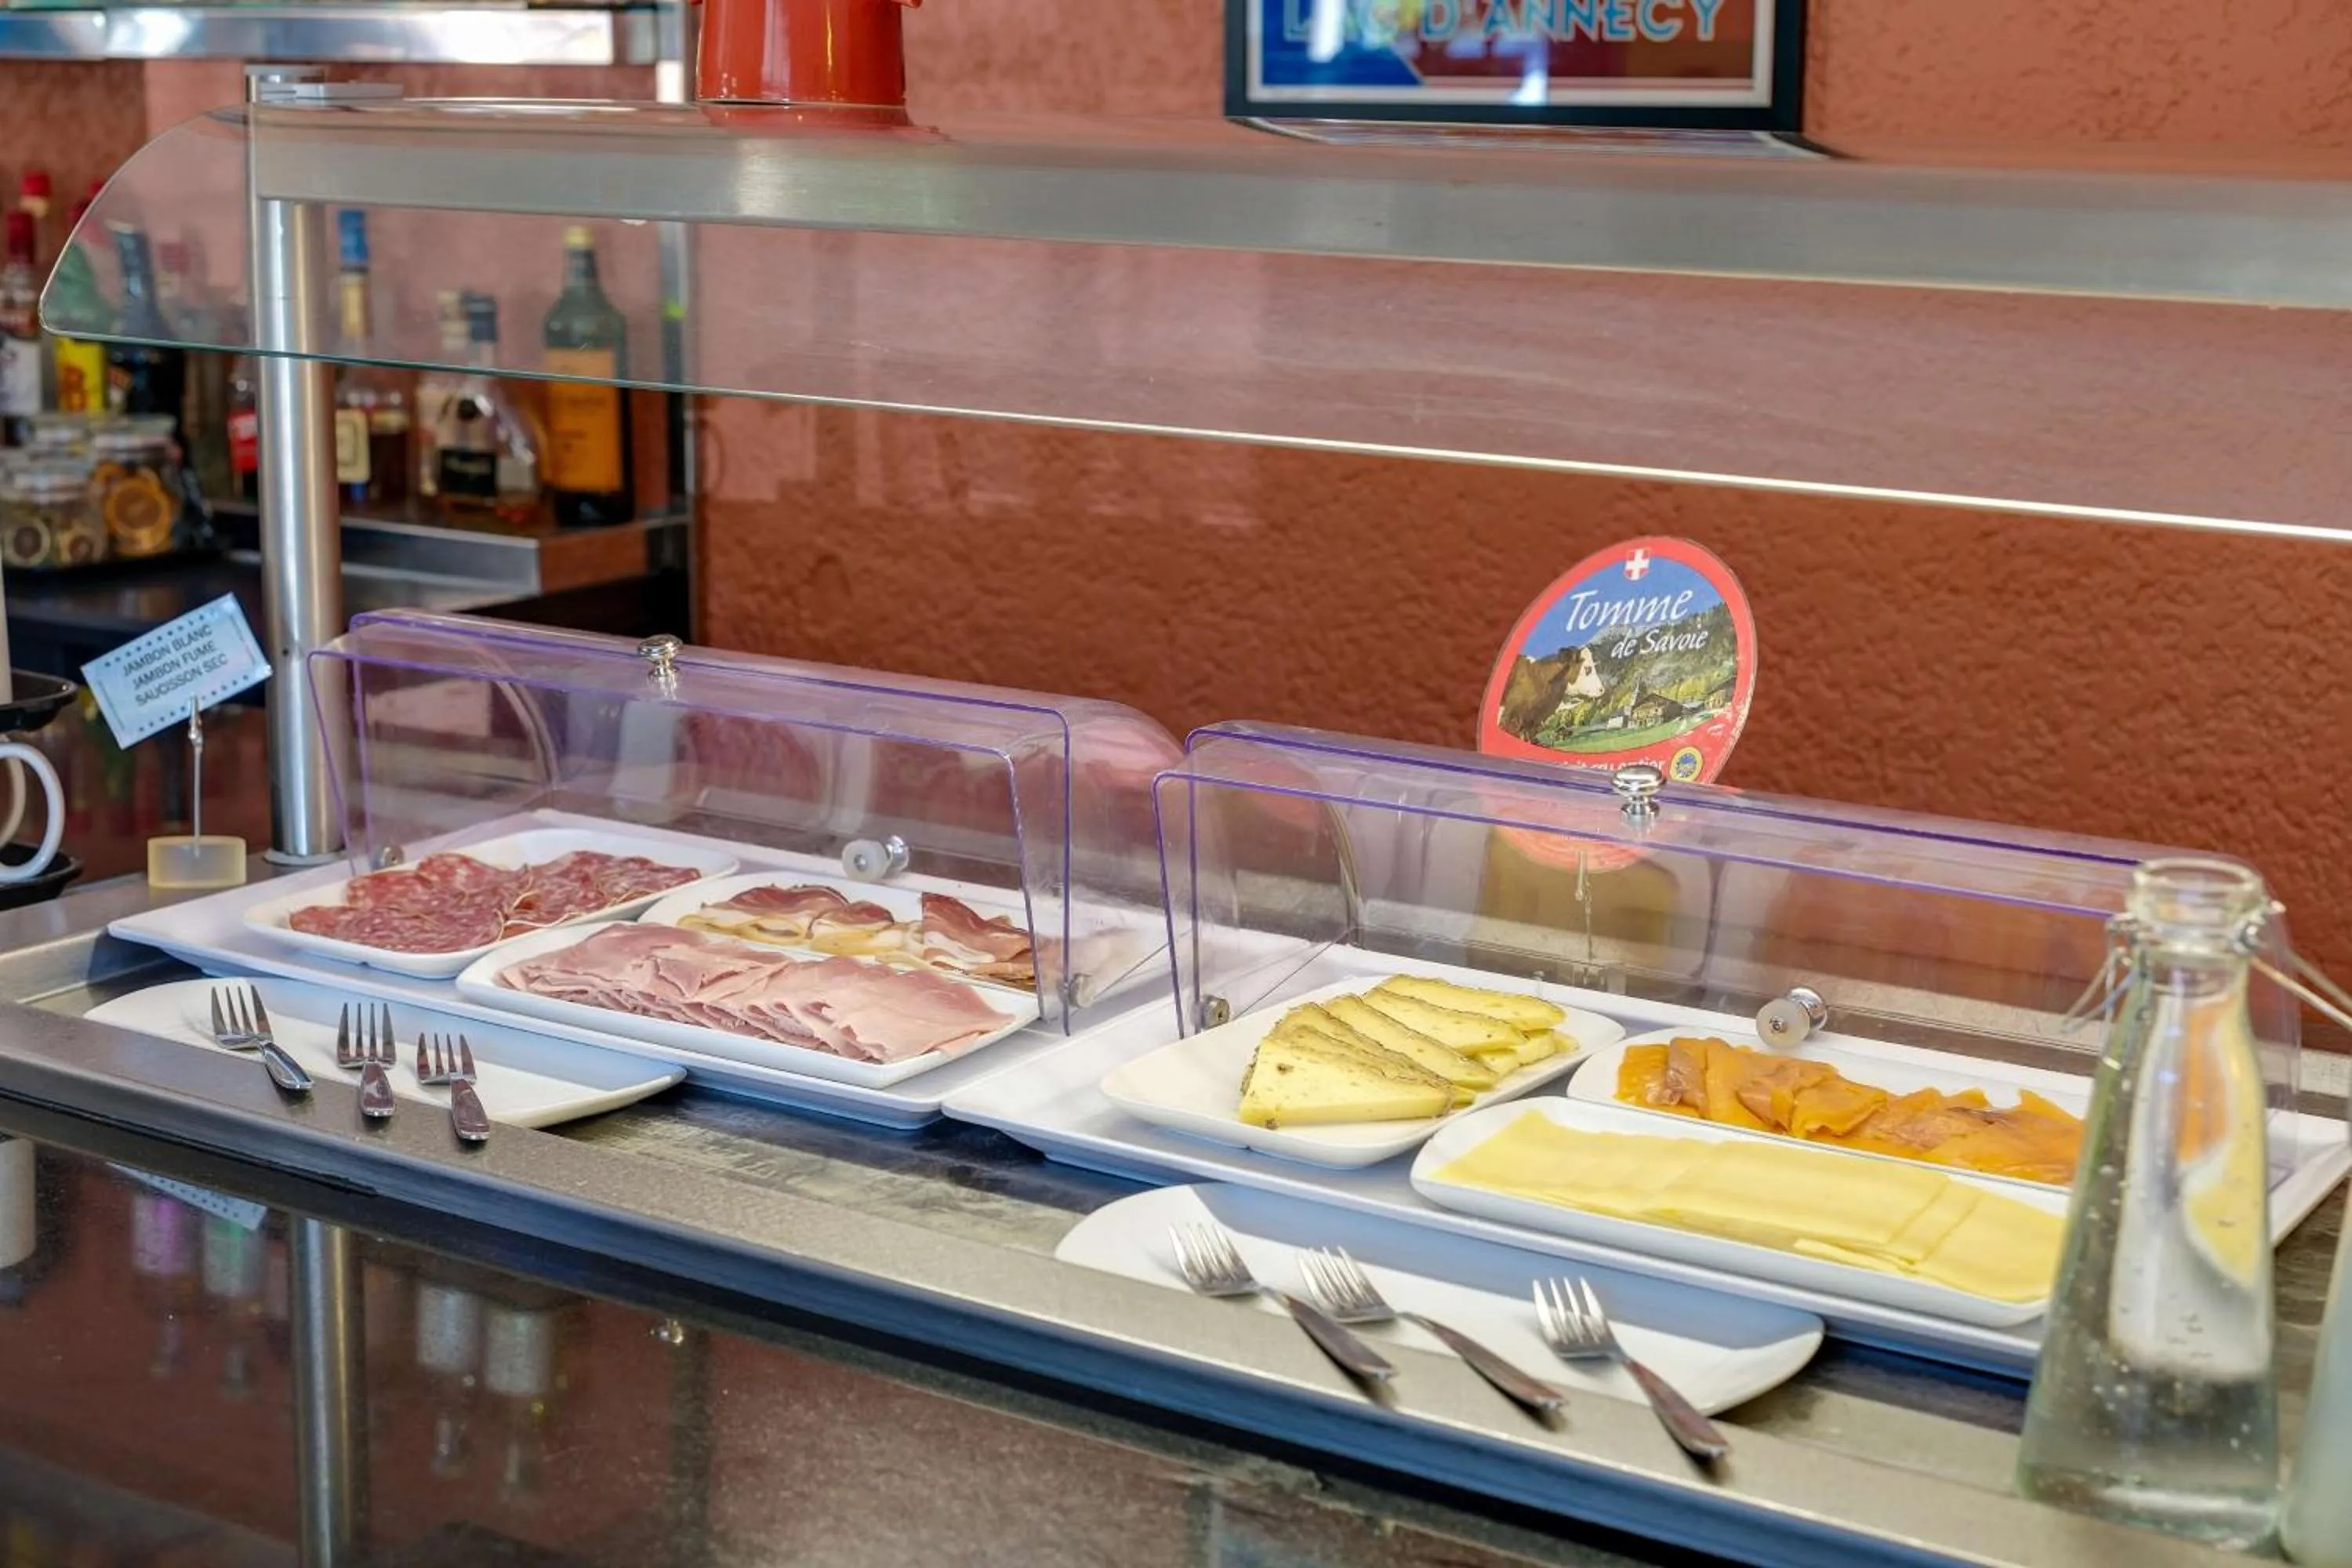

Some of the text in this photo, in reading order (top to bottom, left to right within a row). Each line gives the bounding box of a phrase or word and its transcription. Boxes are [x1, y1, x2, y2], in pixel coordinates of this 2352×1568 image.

[1566, 590, 1693, 632] Tomme
[123, 624, 212, 677] JAMBON BLANC
[1611, 624, 1708, 659] de Savoie
[132, 659, 181, 690] JAMBON
[202, 653, 228, 673] SEC
